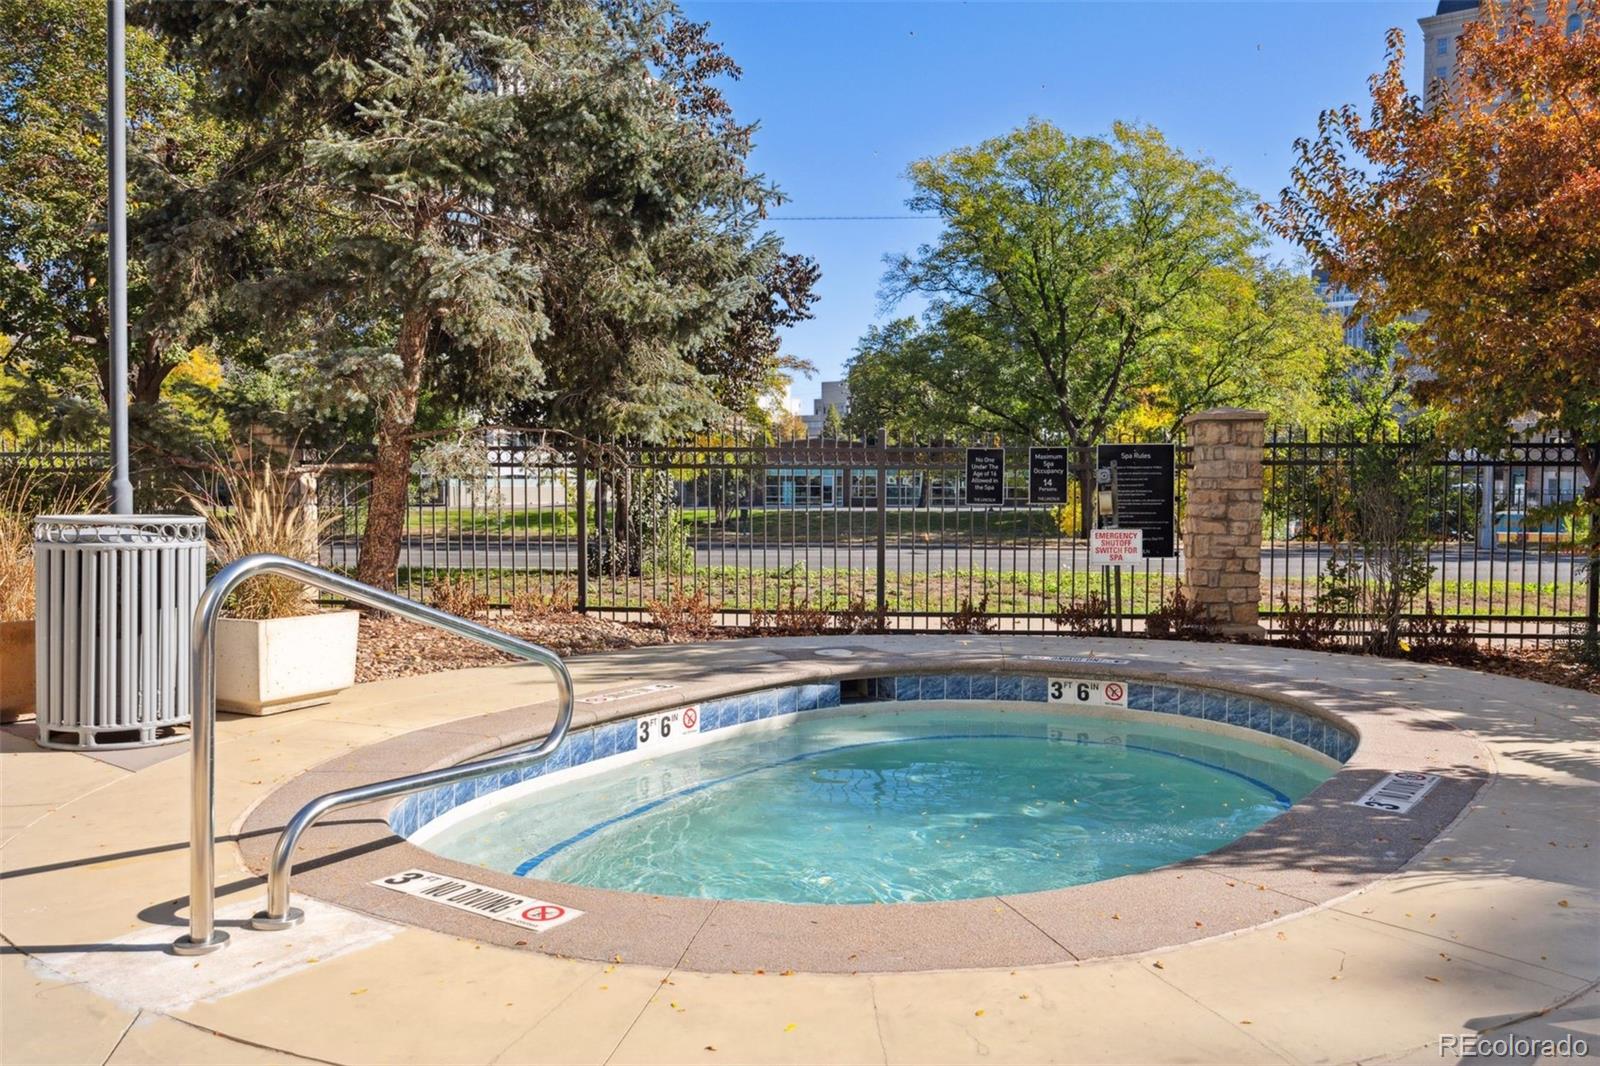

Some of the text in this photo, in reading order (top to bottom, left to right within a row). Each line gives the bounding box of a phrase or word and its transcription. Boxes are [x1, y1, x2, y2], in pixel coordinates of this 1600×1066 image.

[1121, 452, 1133, 460] Spa
[1043, 461, 1054, 469] Spa
[1094, 532, 1138, 540] EMERGENCY
[1051, 681, 1063, 700] 3
[1077, 683, 1090, 702] 6
[1090, 683, 1099, 691] IN
[639, 713, 679, 743] 3 FT 6 IN
[384, 872, 424, 885] 3
[420, 880, 459, 898] NO
[447, 887, 524, 914] DIVING
